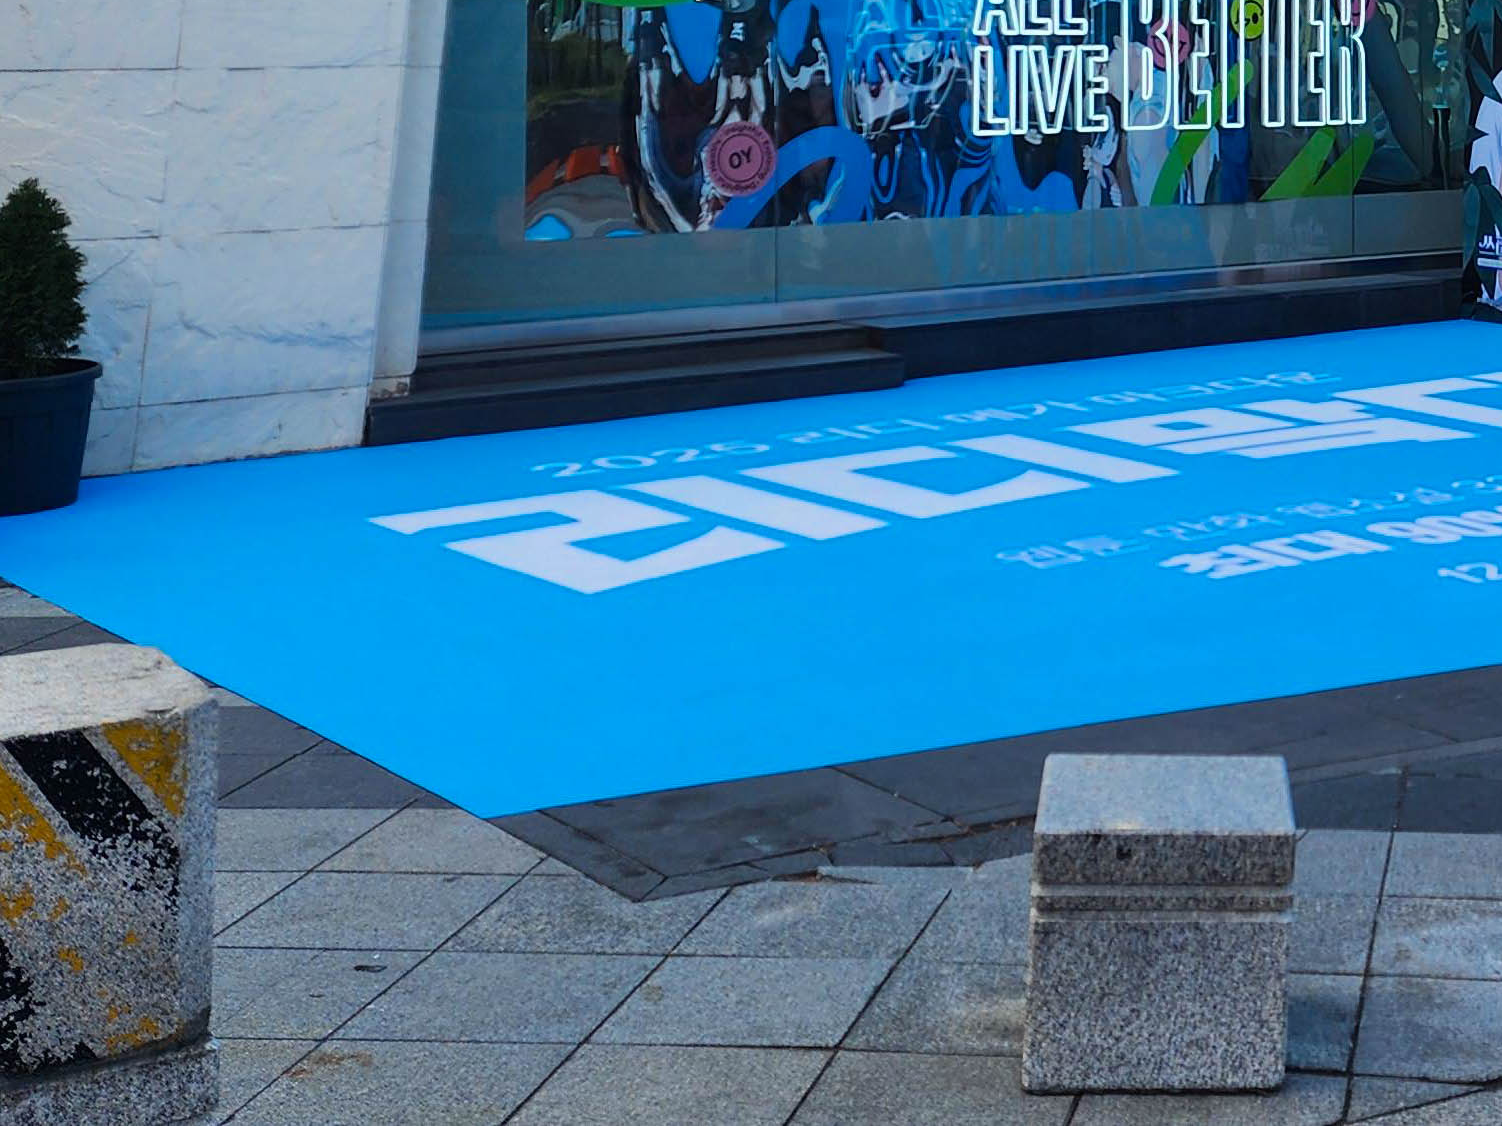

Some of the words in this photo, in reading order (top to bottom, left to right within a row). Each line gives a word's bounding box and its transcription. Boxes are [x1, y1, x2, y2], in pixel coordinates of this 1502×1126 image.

[973, 44, 1109, 136] LIVE
[729, 146, 753, 170] OY
[530, 438, 772, 479] 2025
[1156, 529, 1394, 580] 최대
